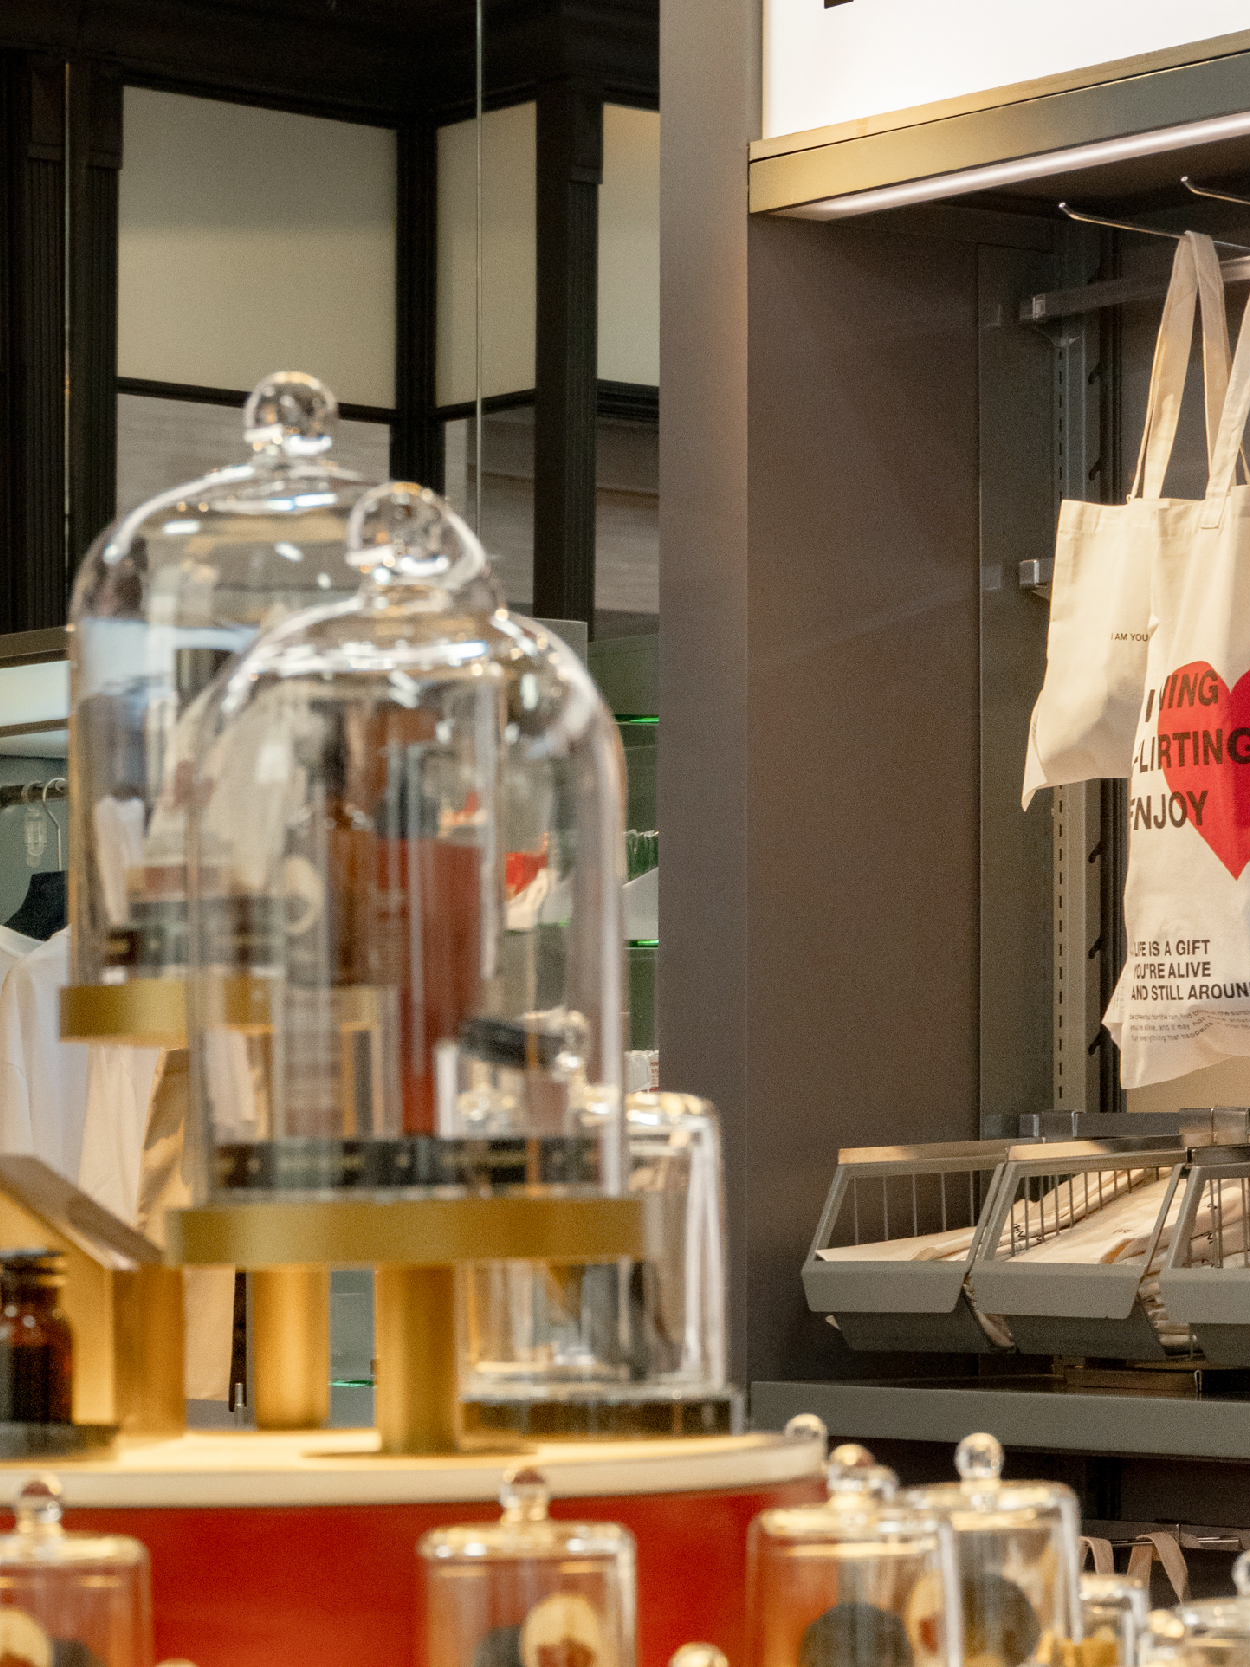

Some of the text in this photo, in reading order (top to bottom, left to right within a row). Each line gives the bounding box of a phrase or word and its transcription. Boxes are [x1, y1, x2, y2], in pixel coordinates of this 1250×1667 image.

[1114, 632, 1128, 641] AM
[1148, 940, 1160, 957] IS
[1164, 940, 1172, 957] A
[1175, 938, 1211, 957] GIFT
[1167, 961, 1212, 980] ALIVE
[1130, 984, 1149, 1002] AND
[1151, 984, 1184, 1002] STILL
